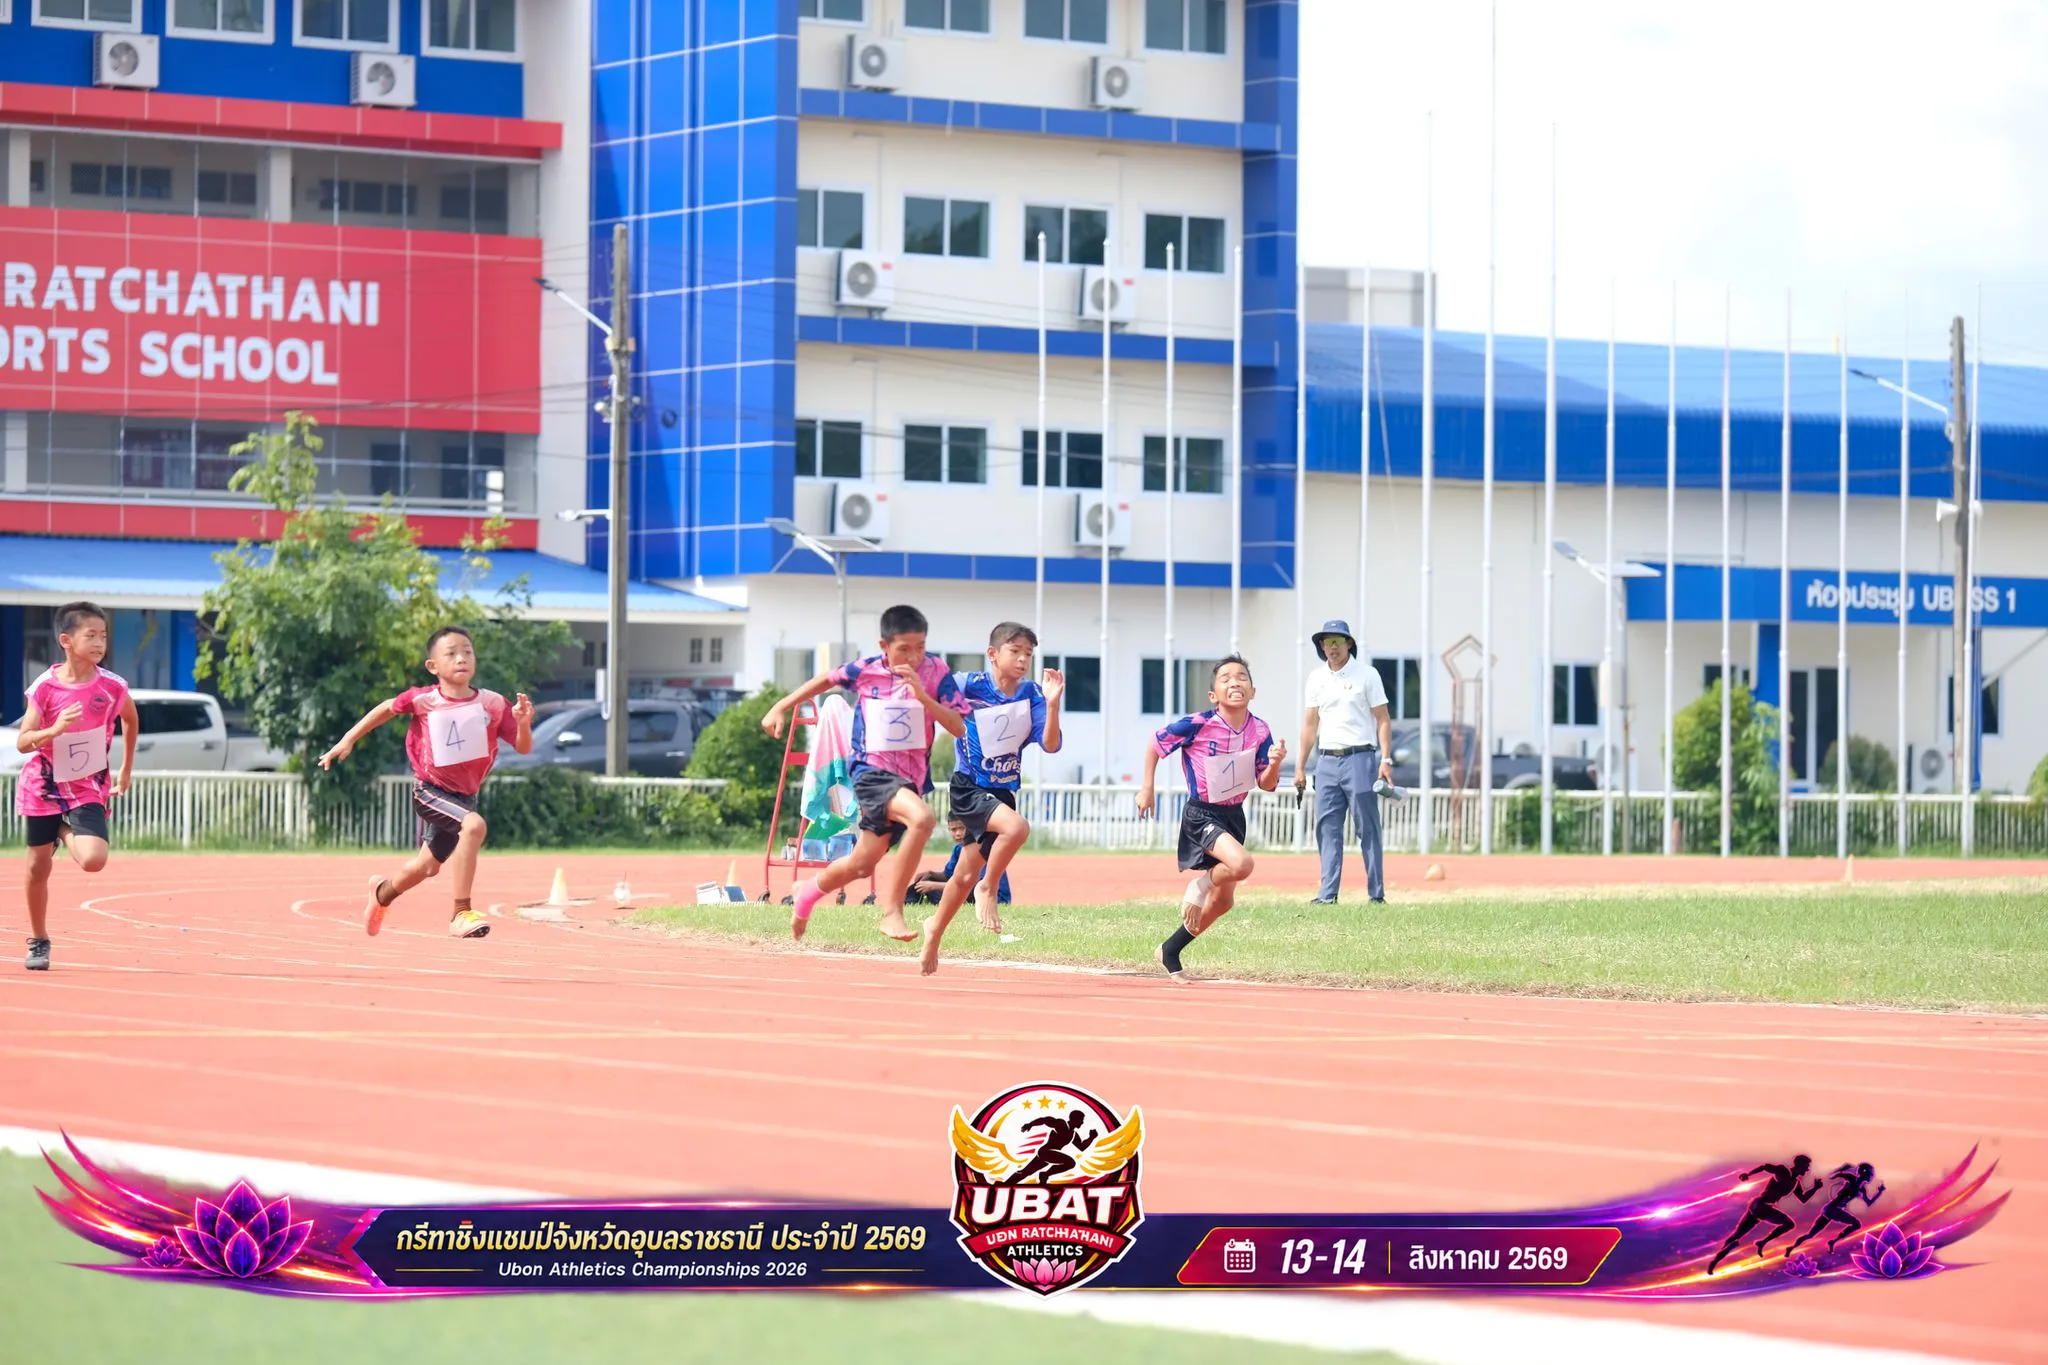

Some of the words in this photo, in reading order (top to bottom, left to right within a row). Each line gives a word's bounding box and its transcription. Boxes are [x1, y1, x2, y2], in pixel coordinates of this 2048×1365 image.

[4, 262, 379, 326] RATCHATHANI
[140, 330, 339, 386] SCHOOL
[1923, 584, 2000, 612] UBSS
[2006, 588, 2017, 613] 1
[446, 720, 466, 751] 4
[884, 706, 912, 742] 3
[994, 714, 1017, 742] 2
[69, 741, 90, 772] 5
[1221, 760, 1244, 793] 1
